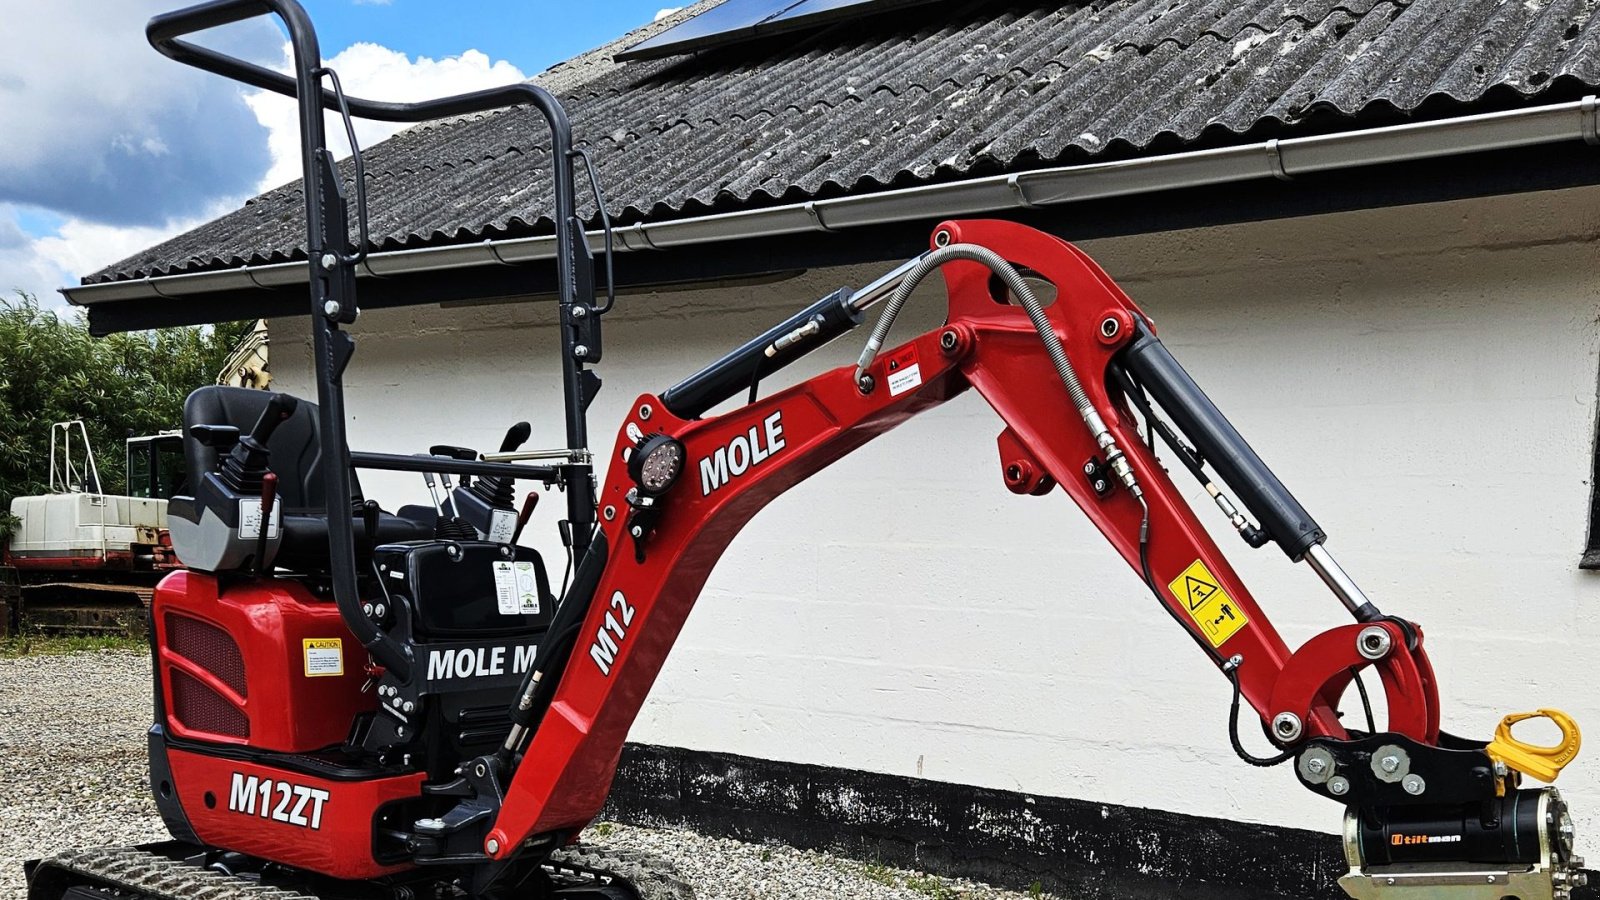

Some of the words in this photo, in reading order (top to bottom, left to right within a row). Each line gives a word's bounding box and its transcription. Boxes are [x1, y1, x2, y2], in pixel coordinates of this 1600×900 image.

[698, 410, 787, 497] MOLE
[590, 590, 636, 676] M12
[426, 646, 506, 681] MOLE
[229, 772, 330, 830] M12ZT
[1404, 834, 1462, 844] tiltman
